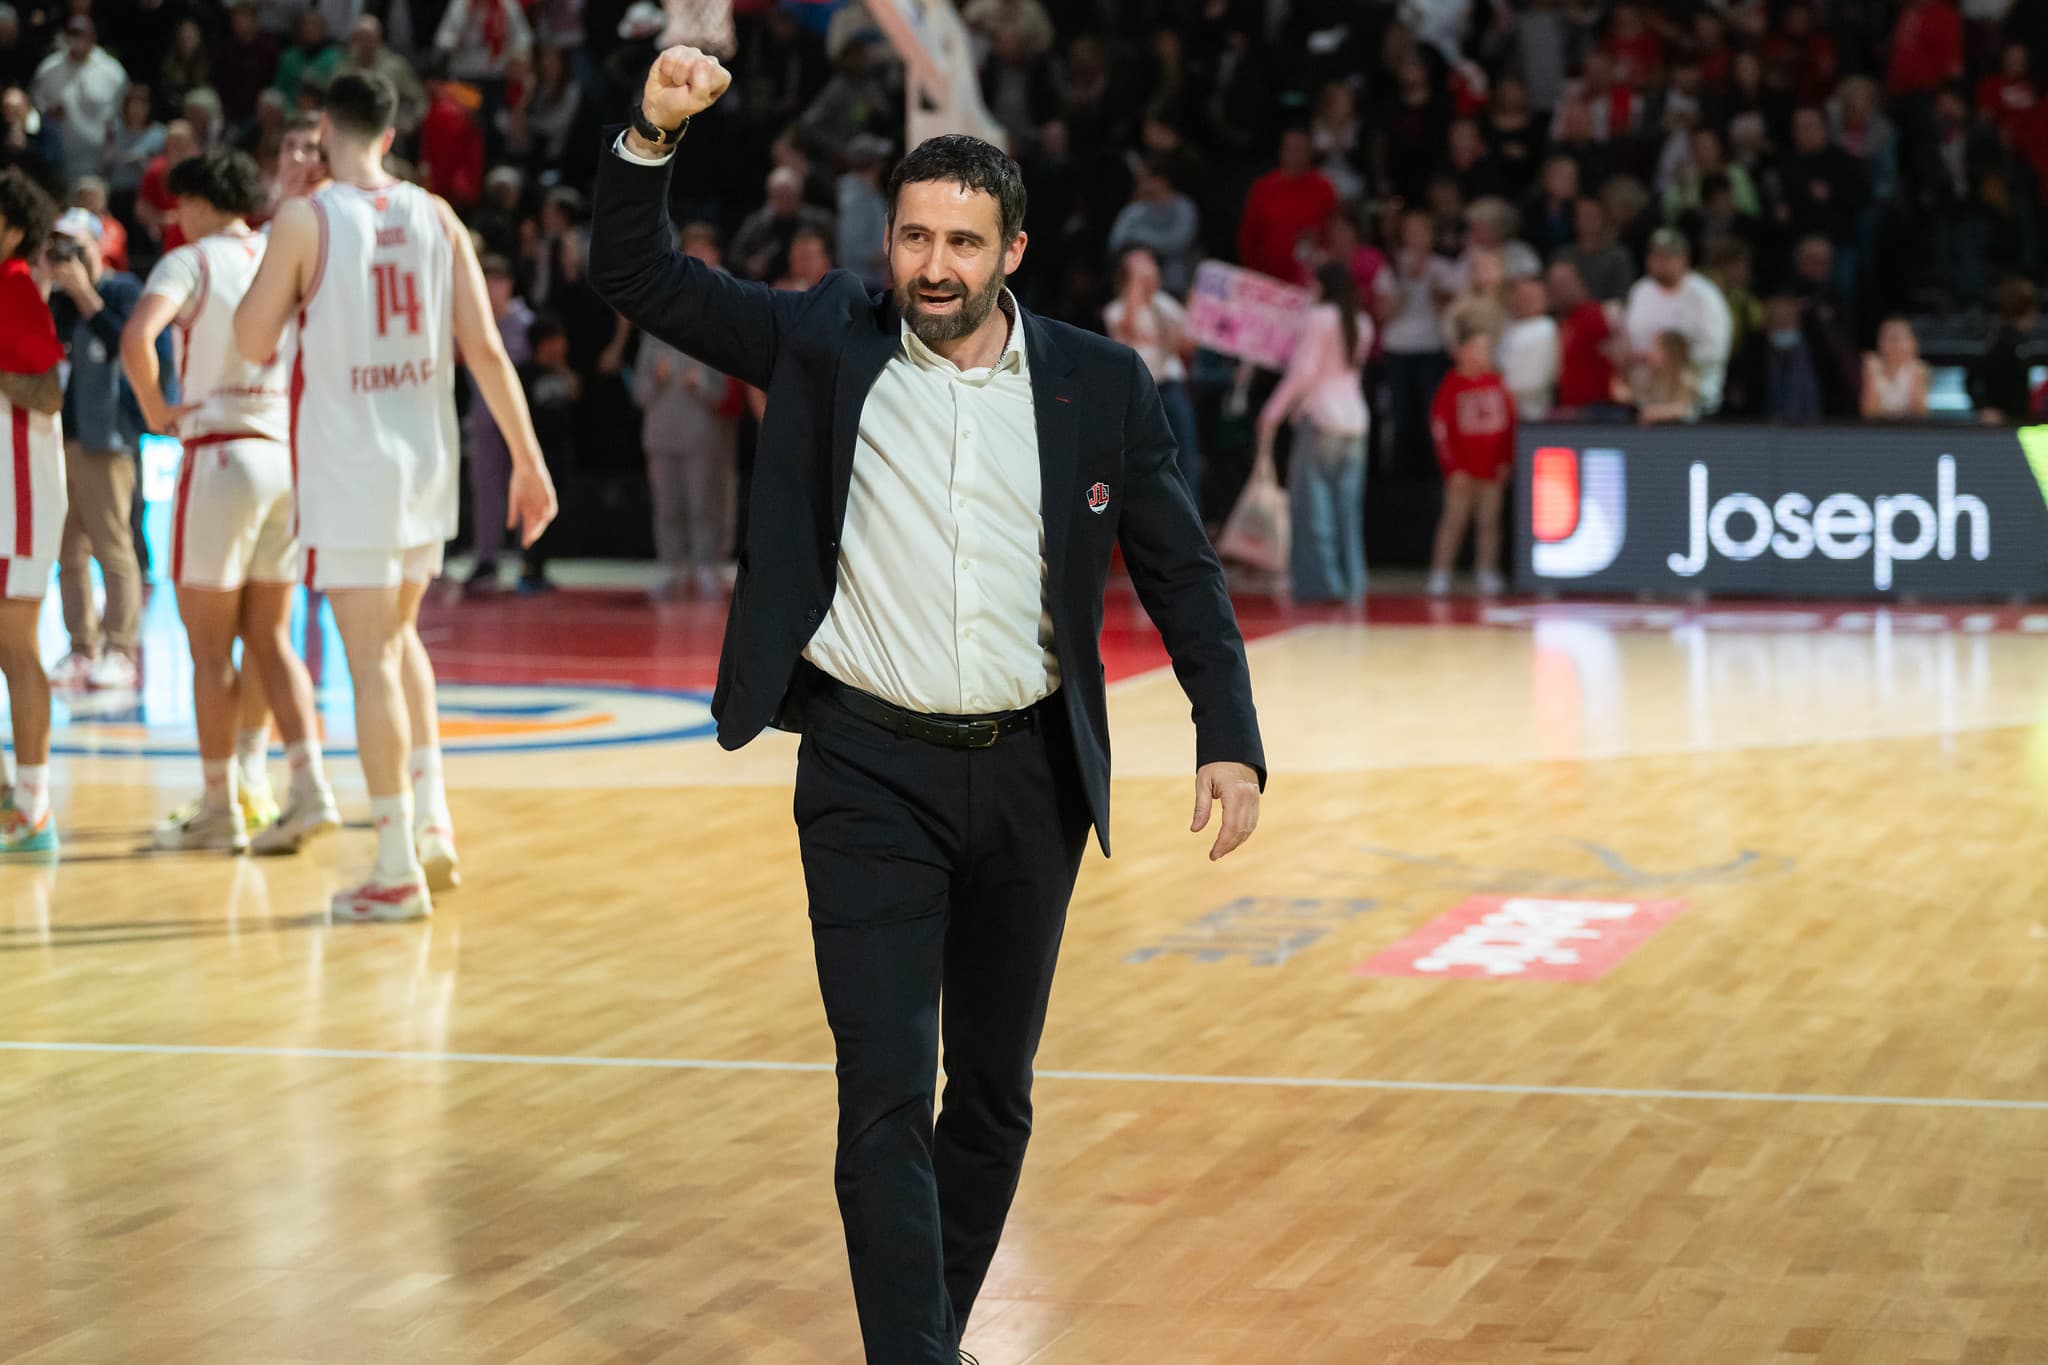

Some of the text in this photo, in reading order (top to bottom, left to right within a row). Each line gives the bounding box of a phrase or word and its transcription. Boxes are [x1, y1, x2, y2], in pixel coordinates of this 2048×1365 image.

[371, 262, 422, 336] 14
[1089, 482, 1109, 507] JL
[1666, 453, 1991, 591] Joseph
